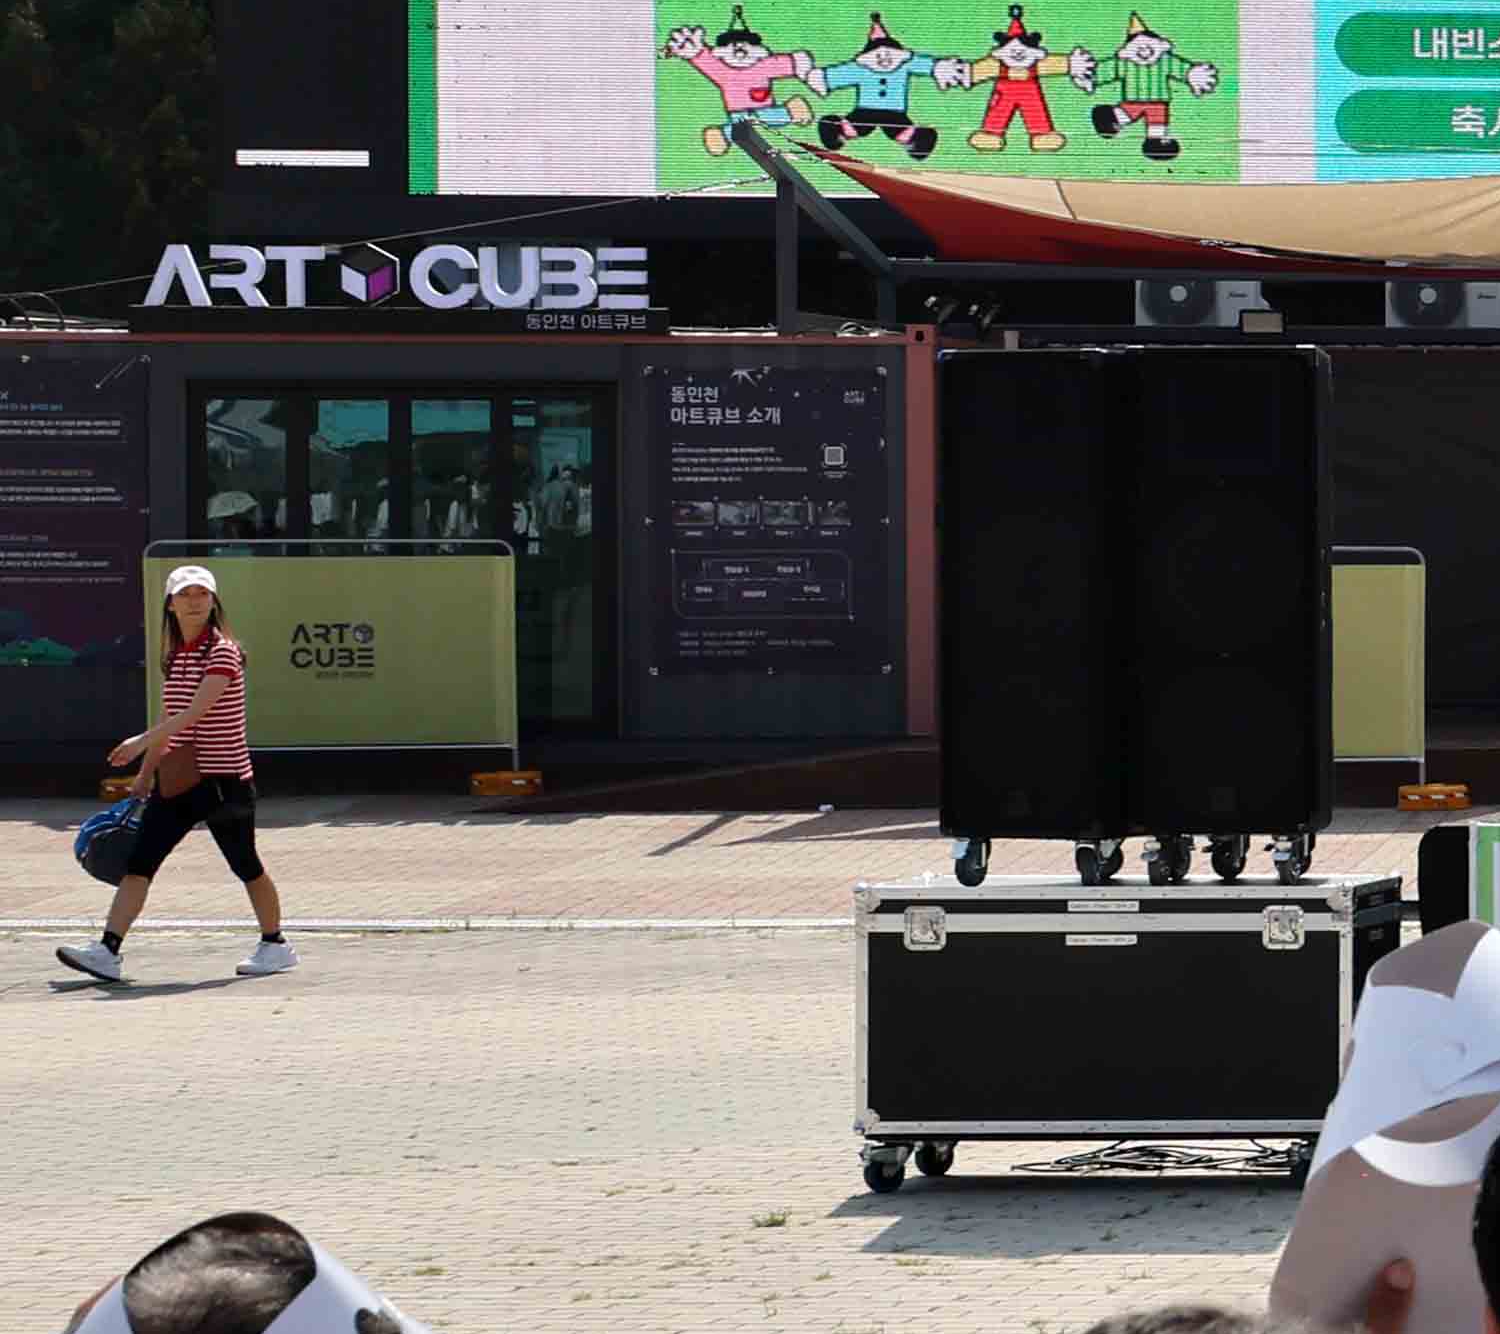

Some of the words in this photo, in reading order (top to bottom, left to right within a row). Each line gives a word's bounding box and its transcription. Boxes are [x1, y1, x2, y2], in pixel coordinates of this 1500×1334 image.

[143, 243, 326, 308] ART
[409, 244, 650, 310] CUBE
[526, 313, 577, 331] 동인천
[581, 313, 648, 331] 아트큐브
[671, 386, 719, 404] 동인천
[746, 406, 781, 426] 소개
[291, 622, 352, 644] ART
[290, 647, 375, 668] CUBE
